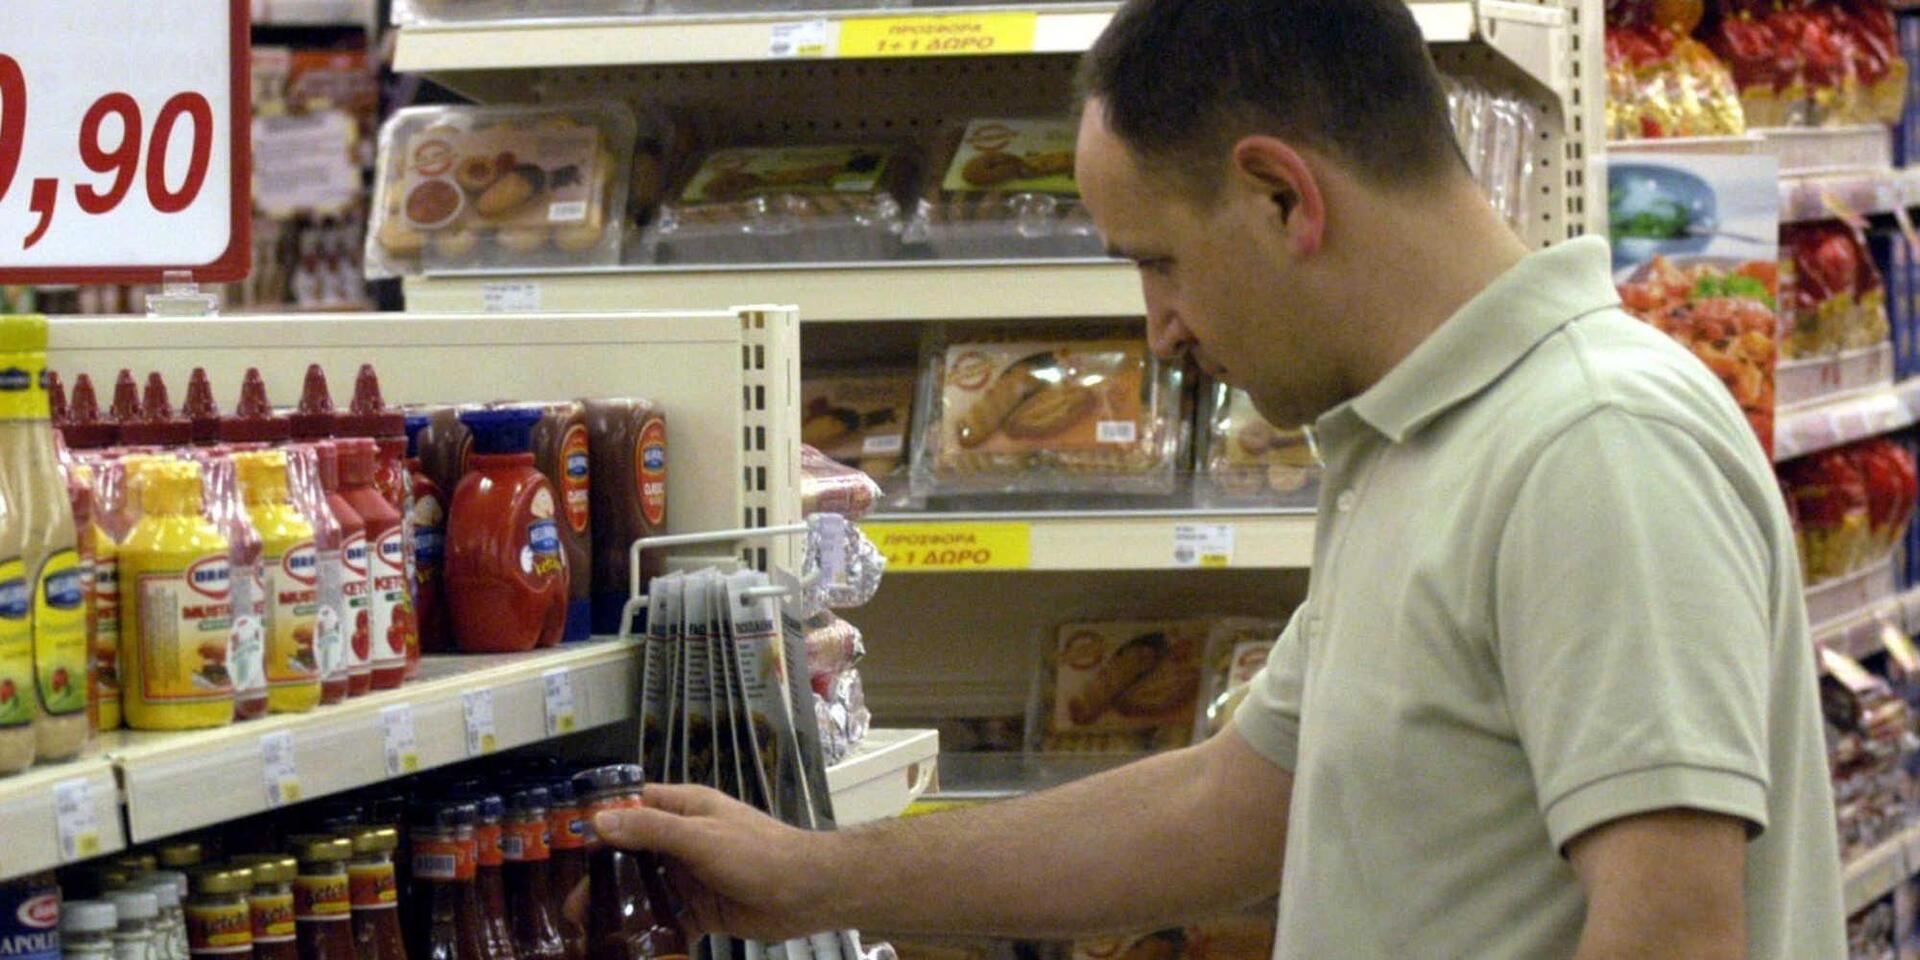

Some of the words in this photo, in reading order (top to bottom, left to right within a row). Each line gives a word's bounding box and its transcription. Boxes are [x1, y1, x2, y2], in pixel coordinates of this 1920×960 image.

[926, 36, 994, 50] ΔΩΡΟ
[884, 533, 976, 546] ΠΡΟΣΦΟΡΑ
[922, 548, 991, 565] ΔΩΡΟ
